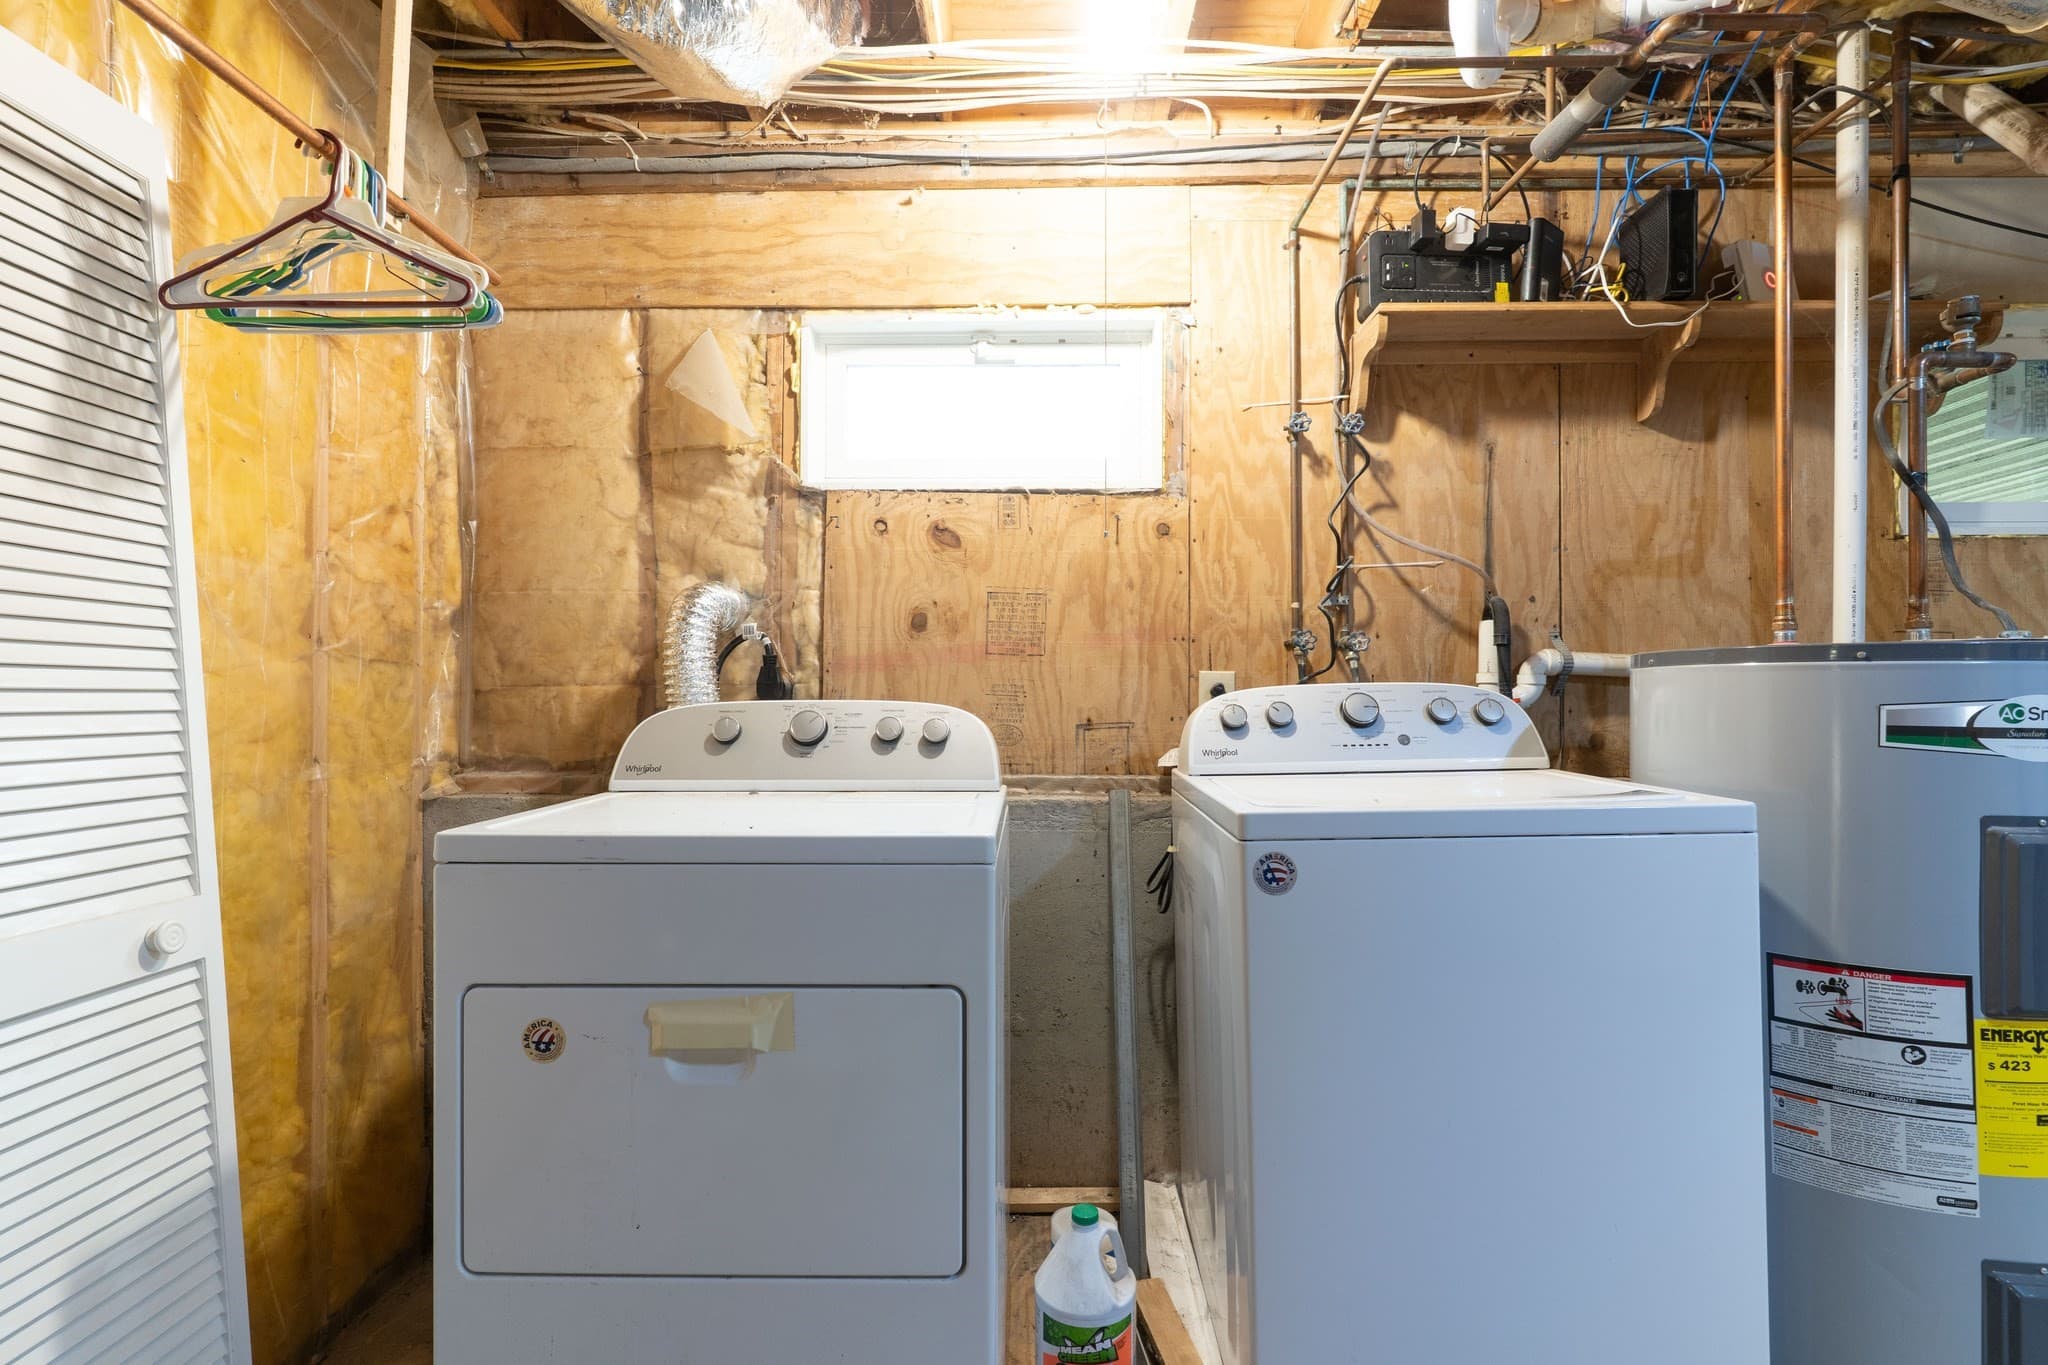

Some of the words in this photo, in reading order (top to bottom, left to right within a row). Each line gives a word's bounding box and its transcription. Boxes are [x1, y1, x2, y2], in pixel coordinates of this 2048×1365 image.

[1201, 747, 1238, 760] Whirlpool
[625, 764, 662, 776] Whirlpool
[1853, 970, 1892, 981] DANGER
[523, 1019, 553, 1049] AMERICA
[2000, 1060, 2031, 1072] 423
